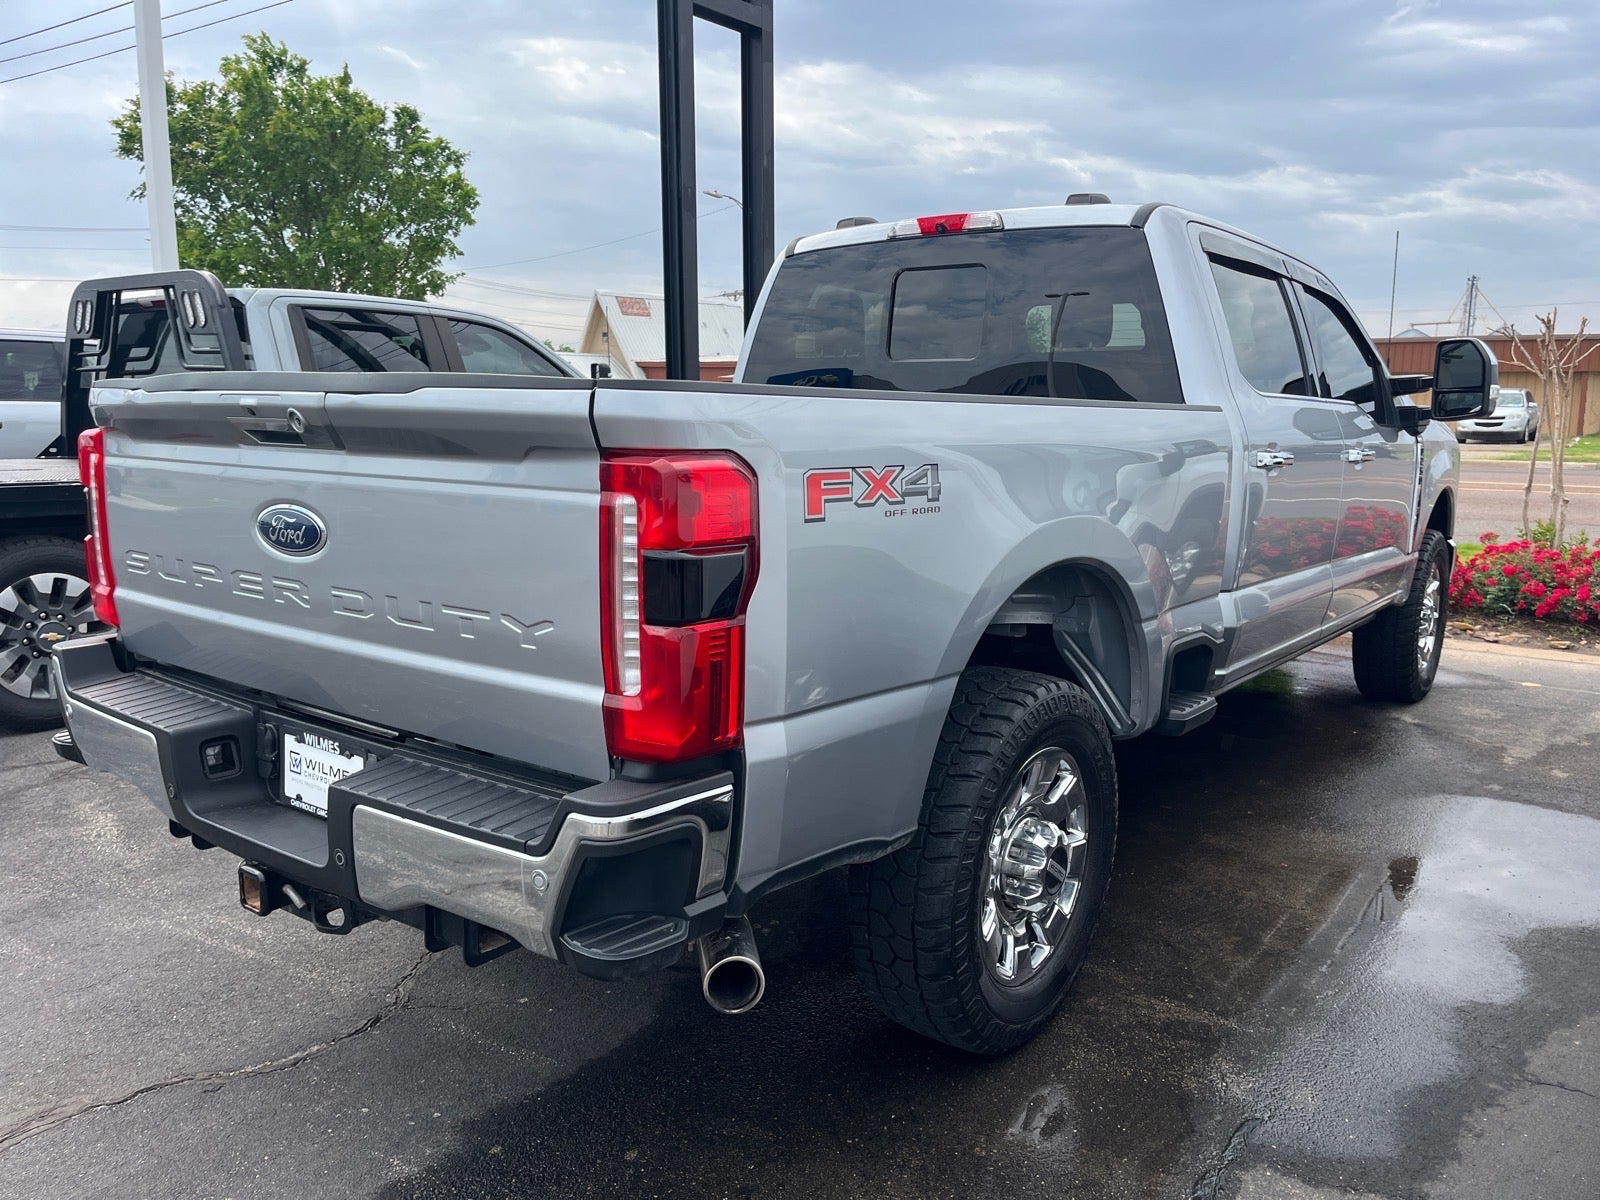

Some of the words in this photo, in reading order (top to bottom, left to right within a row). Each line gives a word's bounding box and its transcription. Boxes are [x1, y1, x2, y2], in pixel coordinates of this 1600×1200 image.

[803, 463, 941, 523] FX4
[884, 508, 907, 517] OFF
[912, 506, 941, 515] ROAD
[268, 514, 306, 544] Ford
[125, 549, 311, 608] SUPER
[331, 585, 554, 650] DUTY
[304, 732, 340, 755] WILMES
[304, 757, 350, 780] WILME
[290, 799, 317, 813] CHEVROLET
[316, 808, 328, 818] GMC
